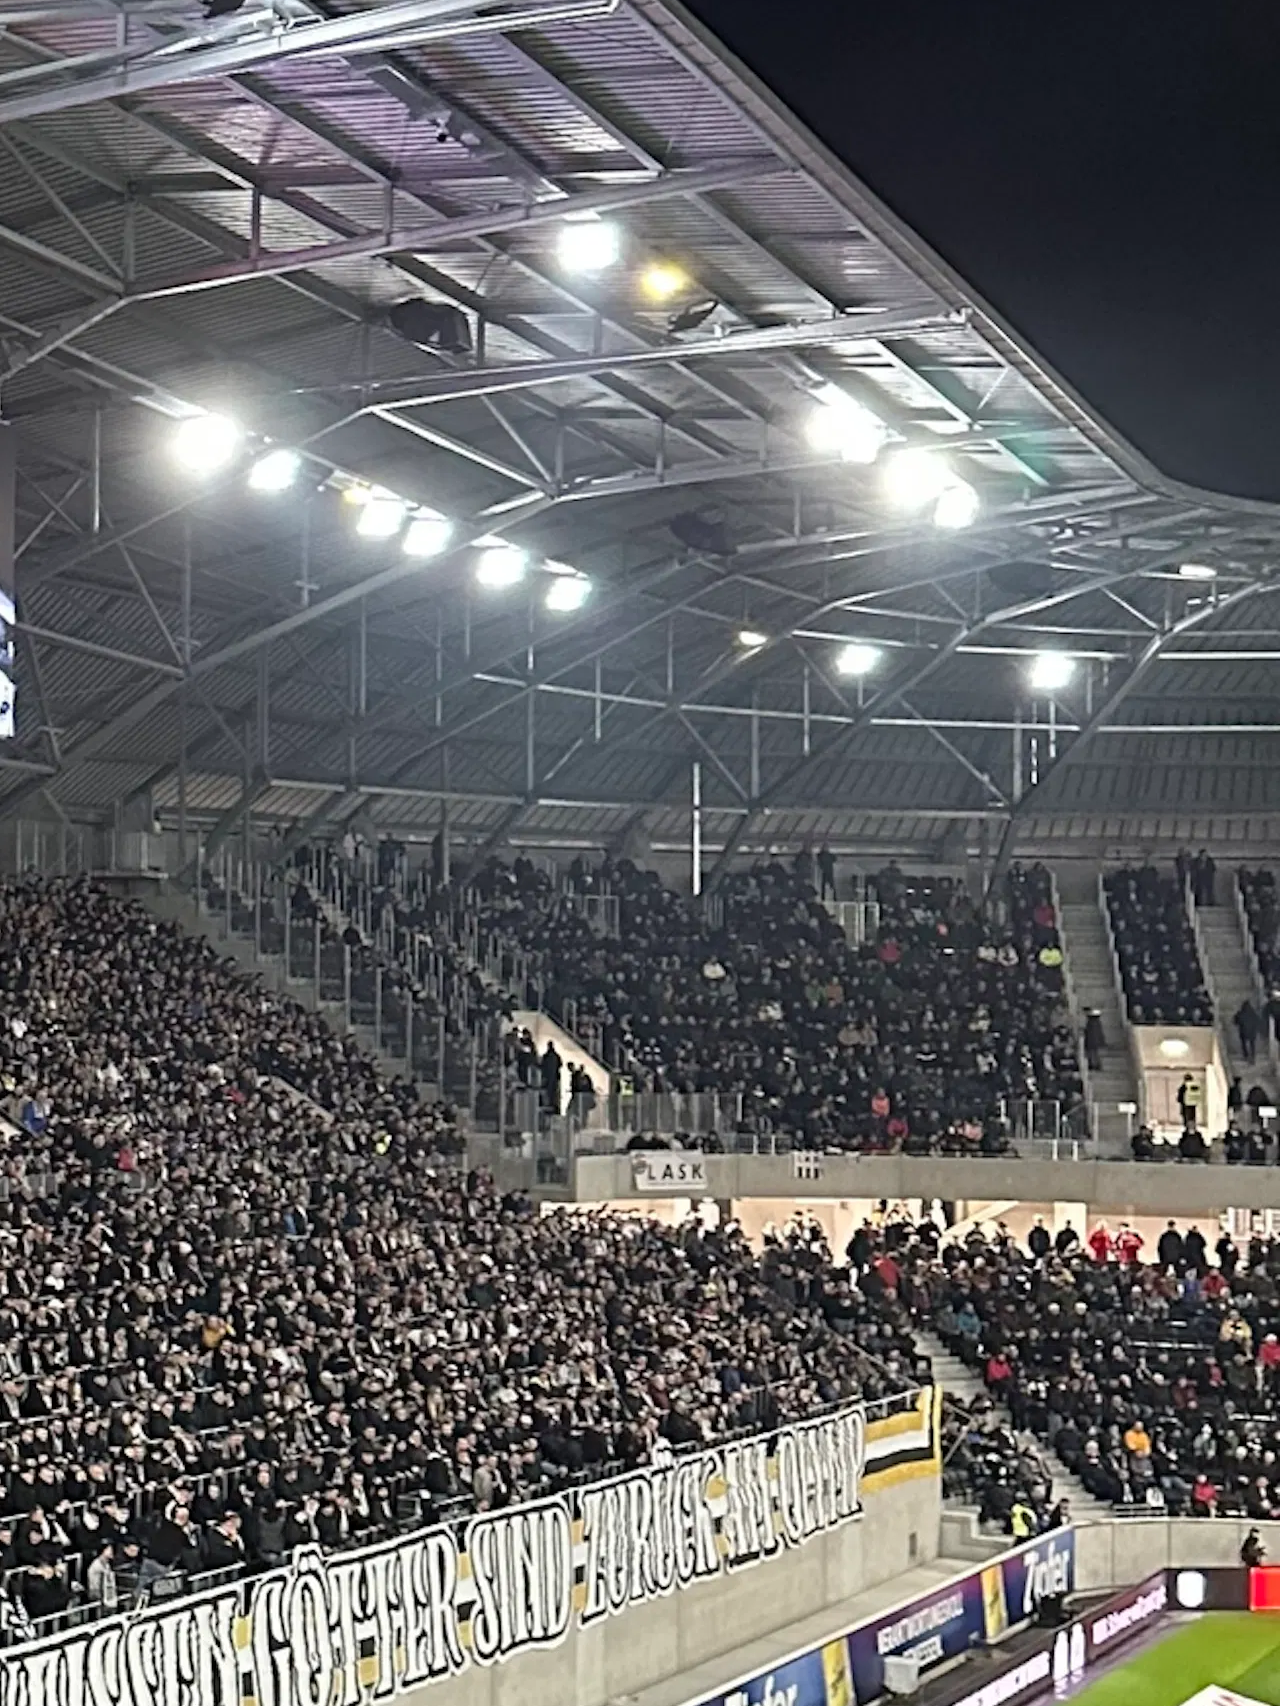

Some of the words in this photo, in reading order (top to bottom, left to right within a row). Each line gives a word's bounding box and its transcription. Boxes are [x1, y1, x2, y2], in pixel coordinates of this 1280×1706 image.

[648, 1163, 704, 1181] LASK
[471, 1502, 571, 1662] SIND
[579, 1440, 720, 1625] ZURÜCK
